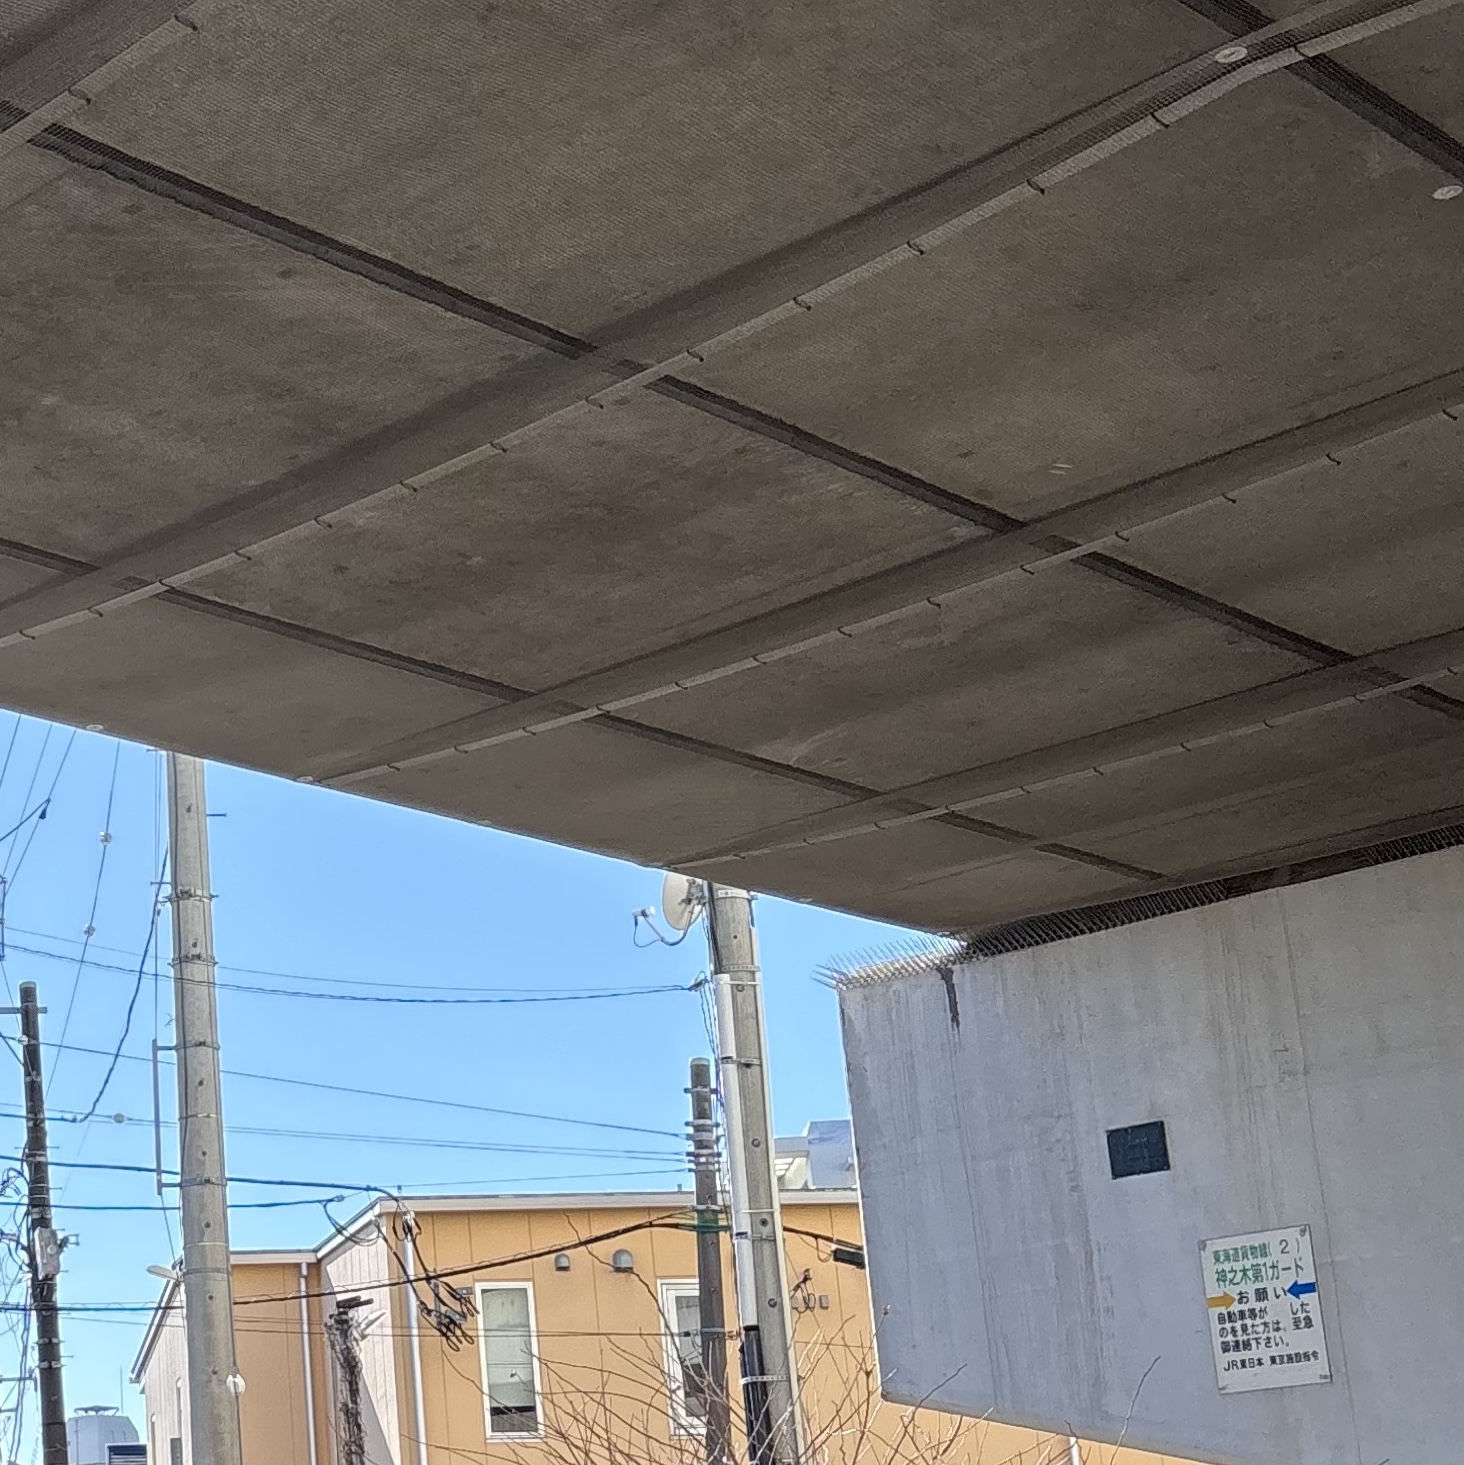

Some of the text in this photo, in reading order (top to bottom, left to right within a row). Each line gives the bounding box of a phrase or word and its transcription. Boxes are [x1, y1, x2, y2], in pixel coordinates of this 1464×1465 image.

[1214, 1256, 1304, 1289] 神之木第1ガード
[1237, 1286, 1288, 1305] お願い
[1223, 1357, 1265, 1372] JR東日本
